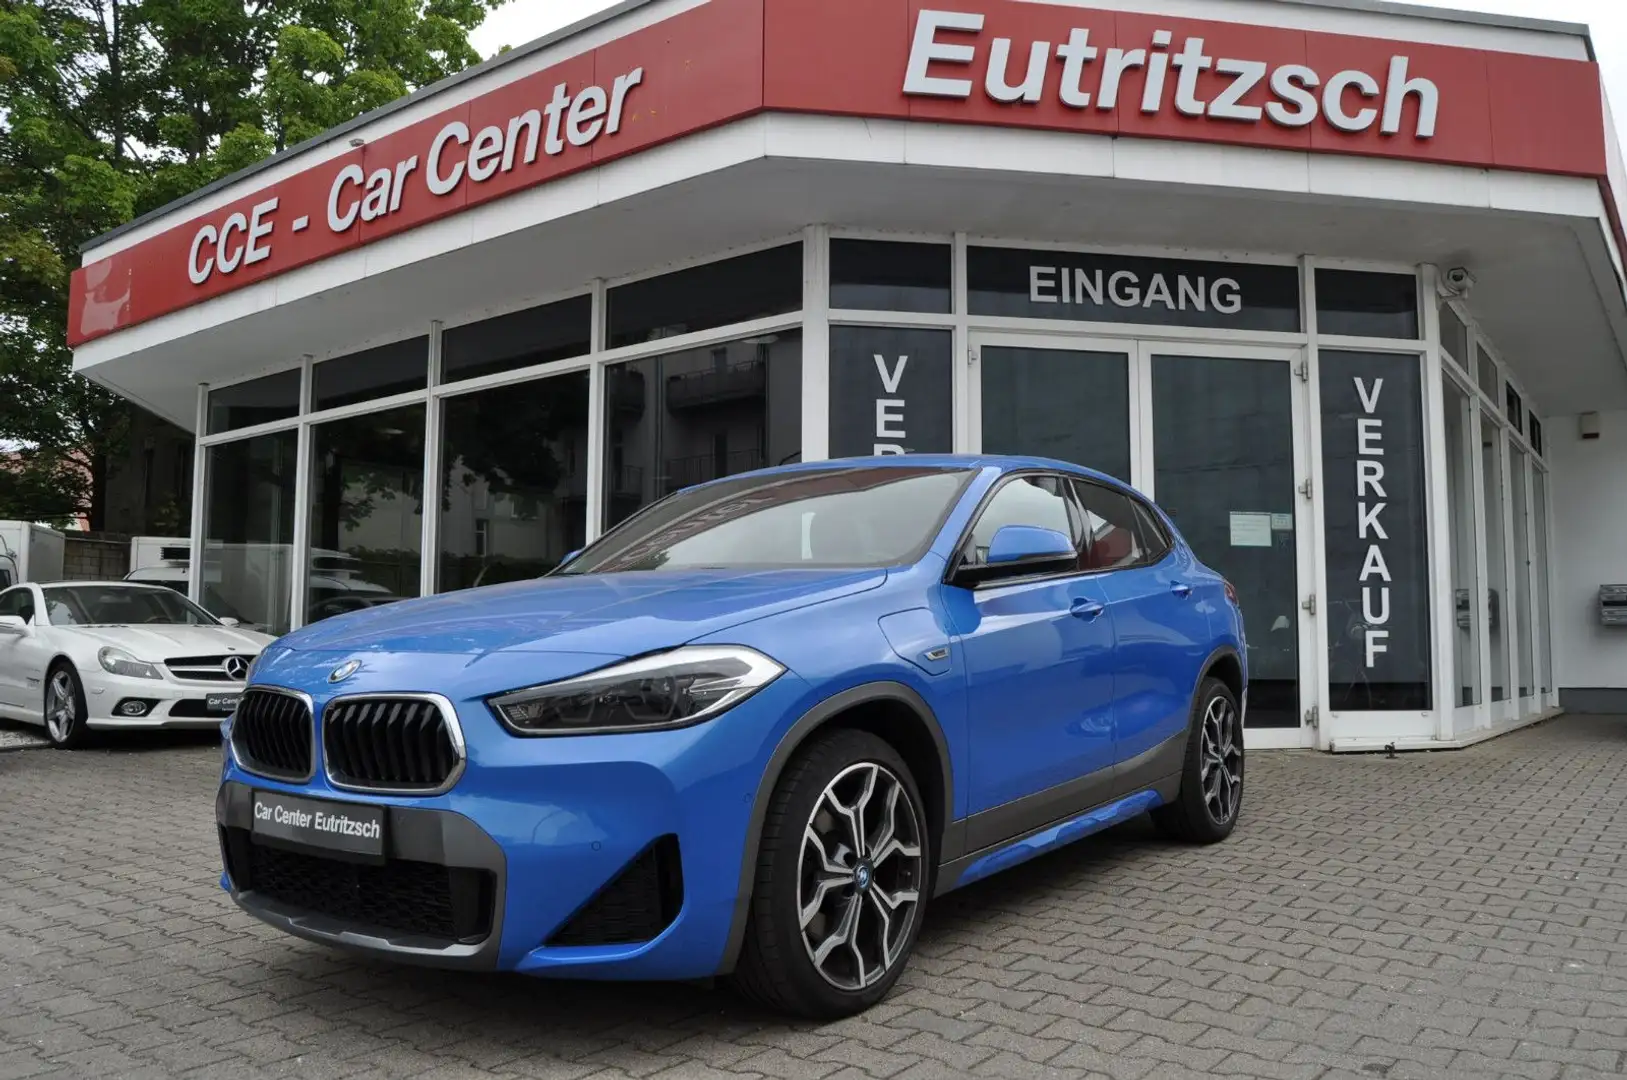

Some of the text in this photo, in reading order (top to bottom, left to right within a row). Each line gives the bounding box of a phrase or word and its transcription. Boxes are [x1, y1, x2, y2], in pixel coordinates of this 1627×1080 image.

[902, 9, 1438, 138] Eutritzsch
[188, 197, 279, 284] CCE
[327, 155, 418, 232] Car
[426, 67, 643, 195] Center
[1029, 266, 1242, 314] EINGANG
[1353, 376, 1392, 668] VERKAUF
[254, 801, 380, 839] Car Center Eutritzsch
